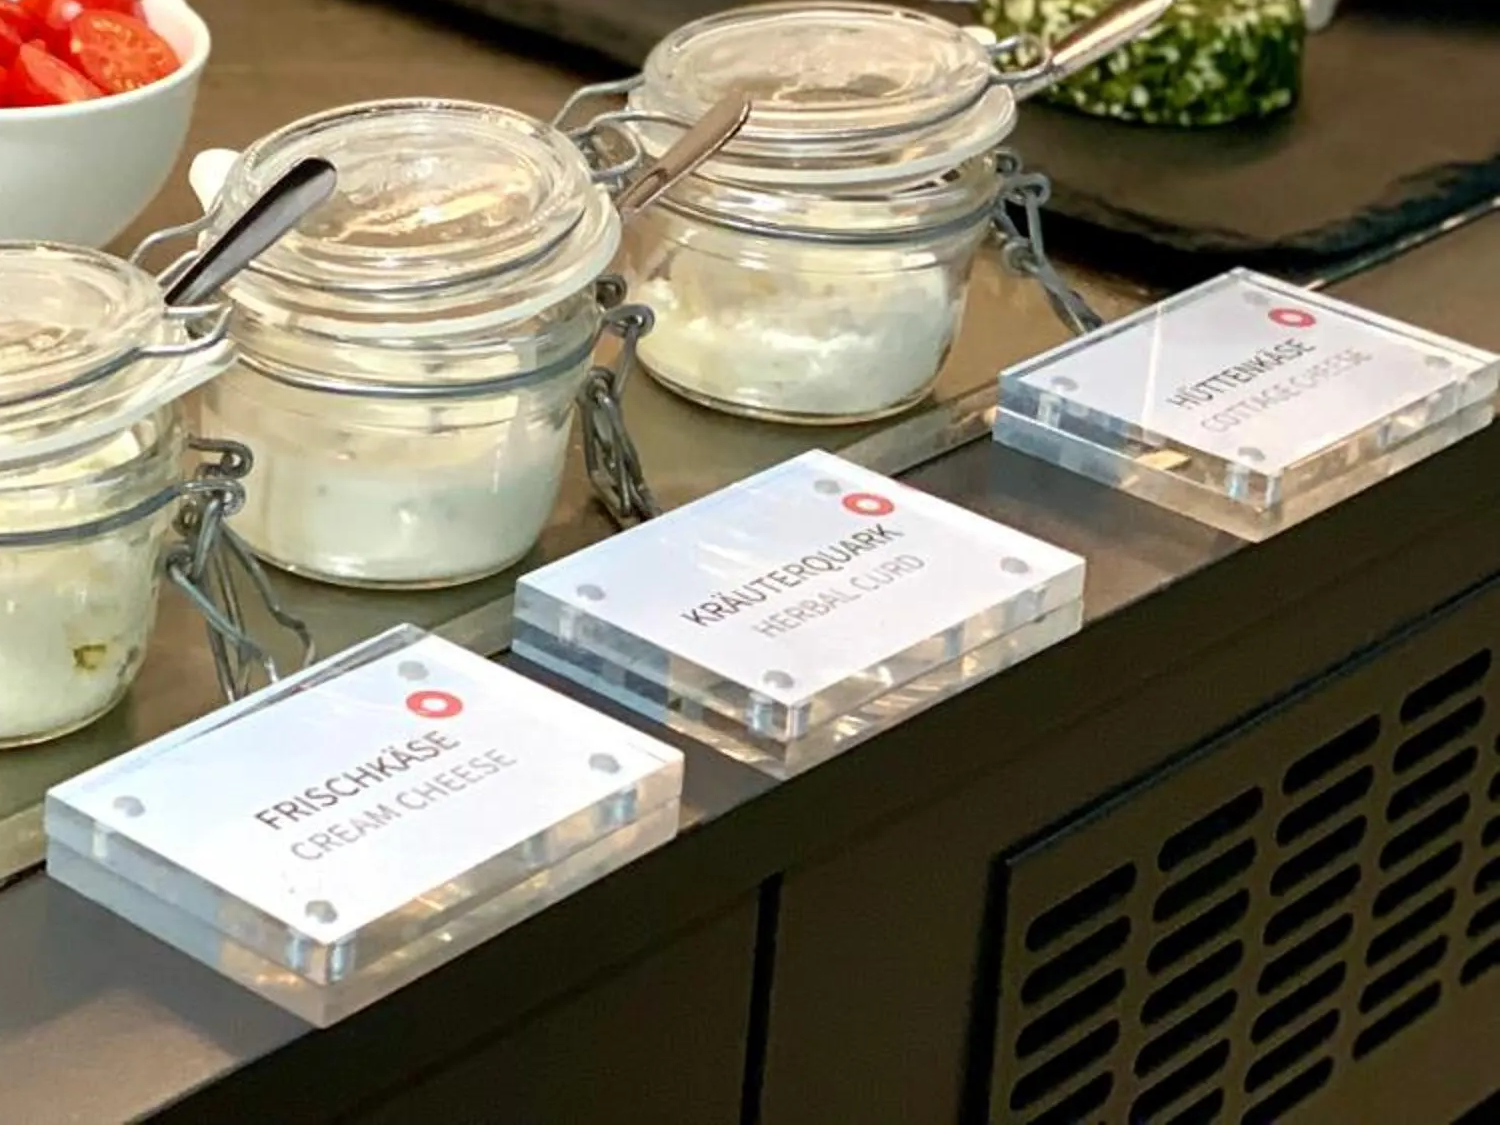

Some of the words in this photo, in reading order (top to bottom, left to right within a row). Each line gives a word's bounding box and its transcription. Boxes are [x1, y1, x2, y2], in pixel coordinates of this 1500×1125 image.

[680, 523, 904, 627] KRÄUTERQUARK
[753, 585, 861, 638] HERBAL
[850, 554, 925, 593] CURD
[254, 730, 461, 831] FRISCHKÄSE
[290, 803, 402, 861] CREAM
[396, 747, 519, 811] CHEESE
